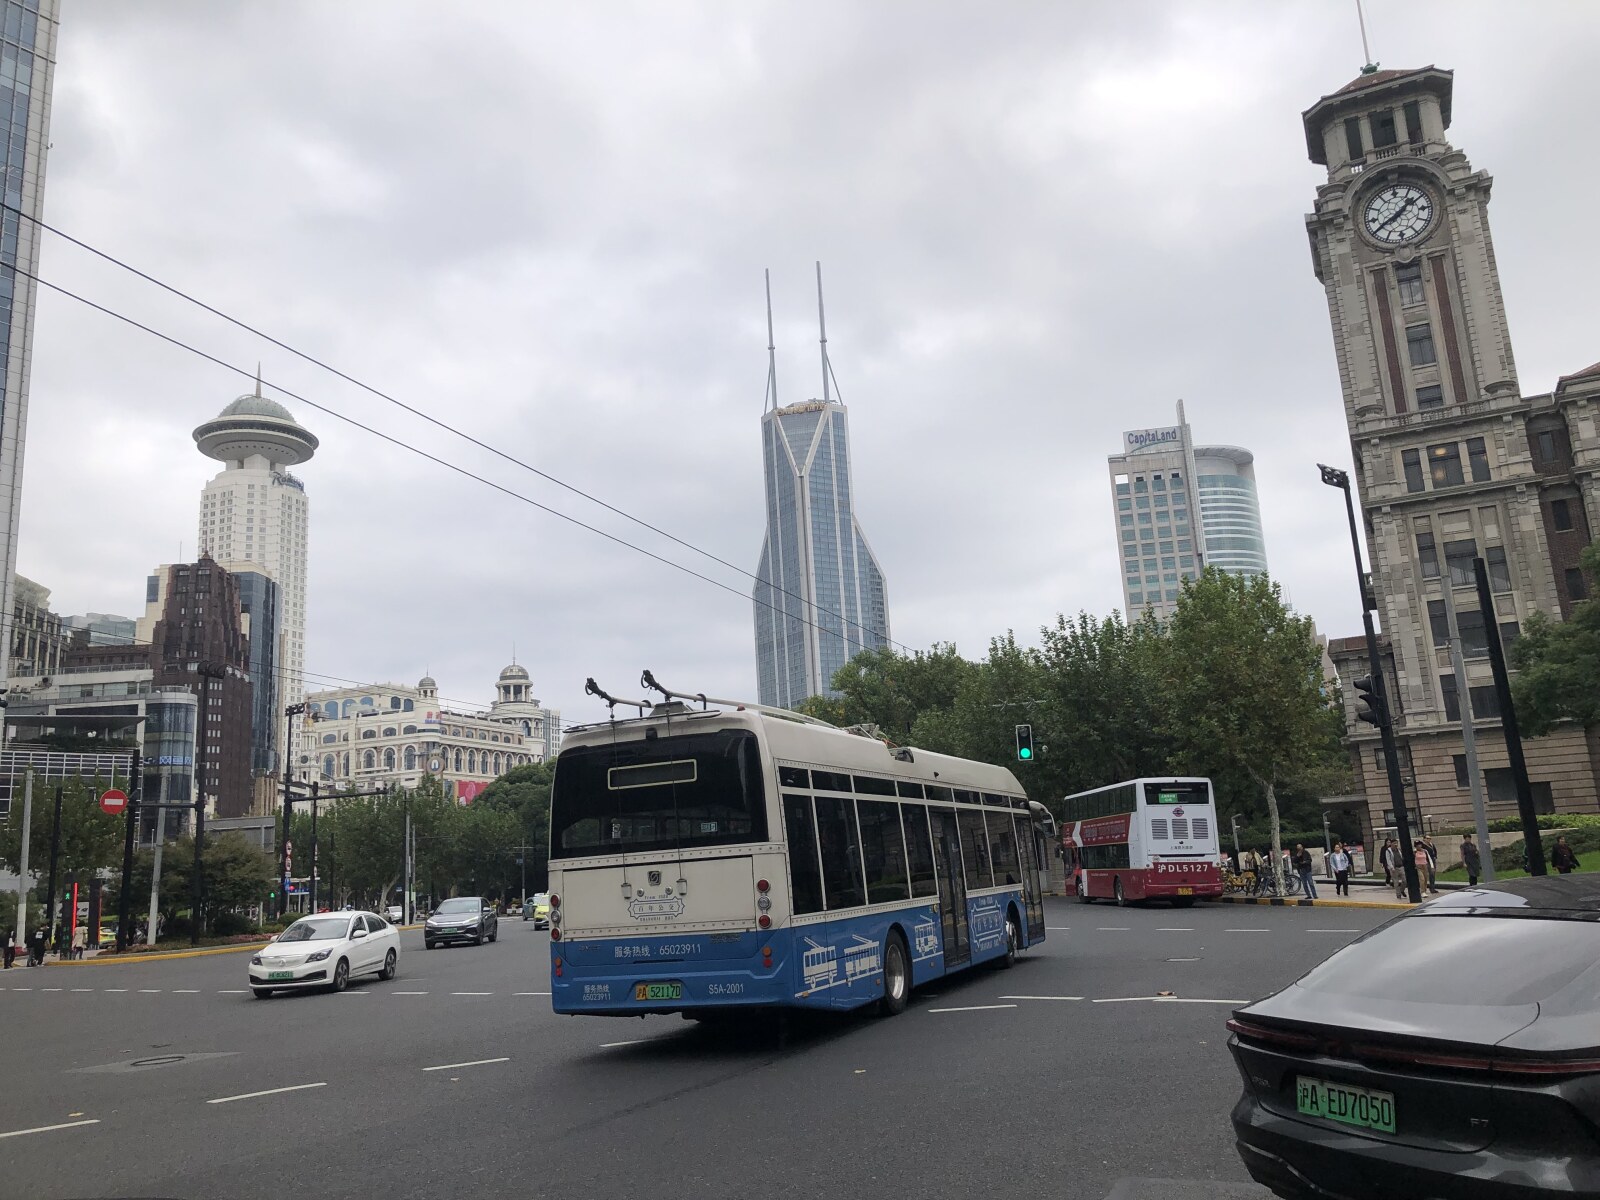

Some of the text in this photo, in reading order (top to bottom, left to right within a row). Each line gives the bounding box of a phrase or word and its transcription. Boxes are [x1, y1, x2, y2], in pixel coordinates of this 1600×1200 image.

[1128, 428, 1177, 445] CapitaLand
[1158, 864, 1208, 873] 沪DL5127
[708, 982, 744, 995] S5A-2001
[582, 992, 611, 1001] 65023911
[1327, 1087, 1392, 1126] ED7050
